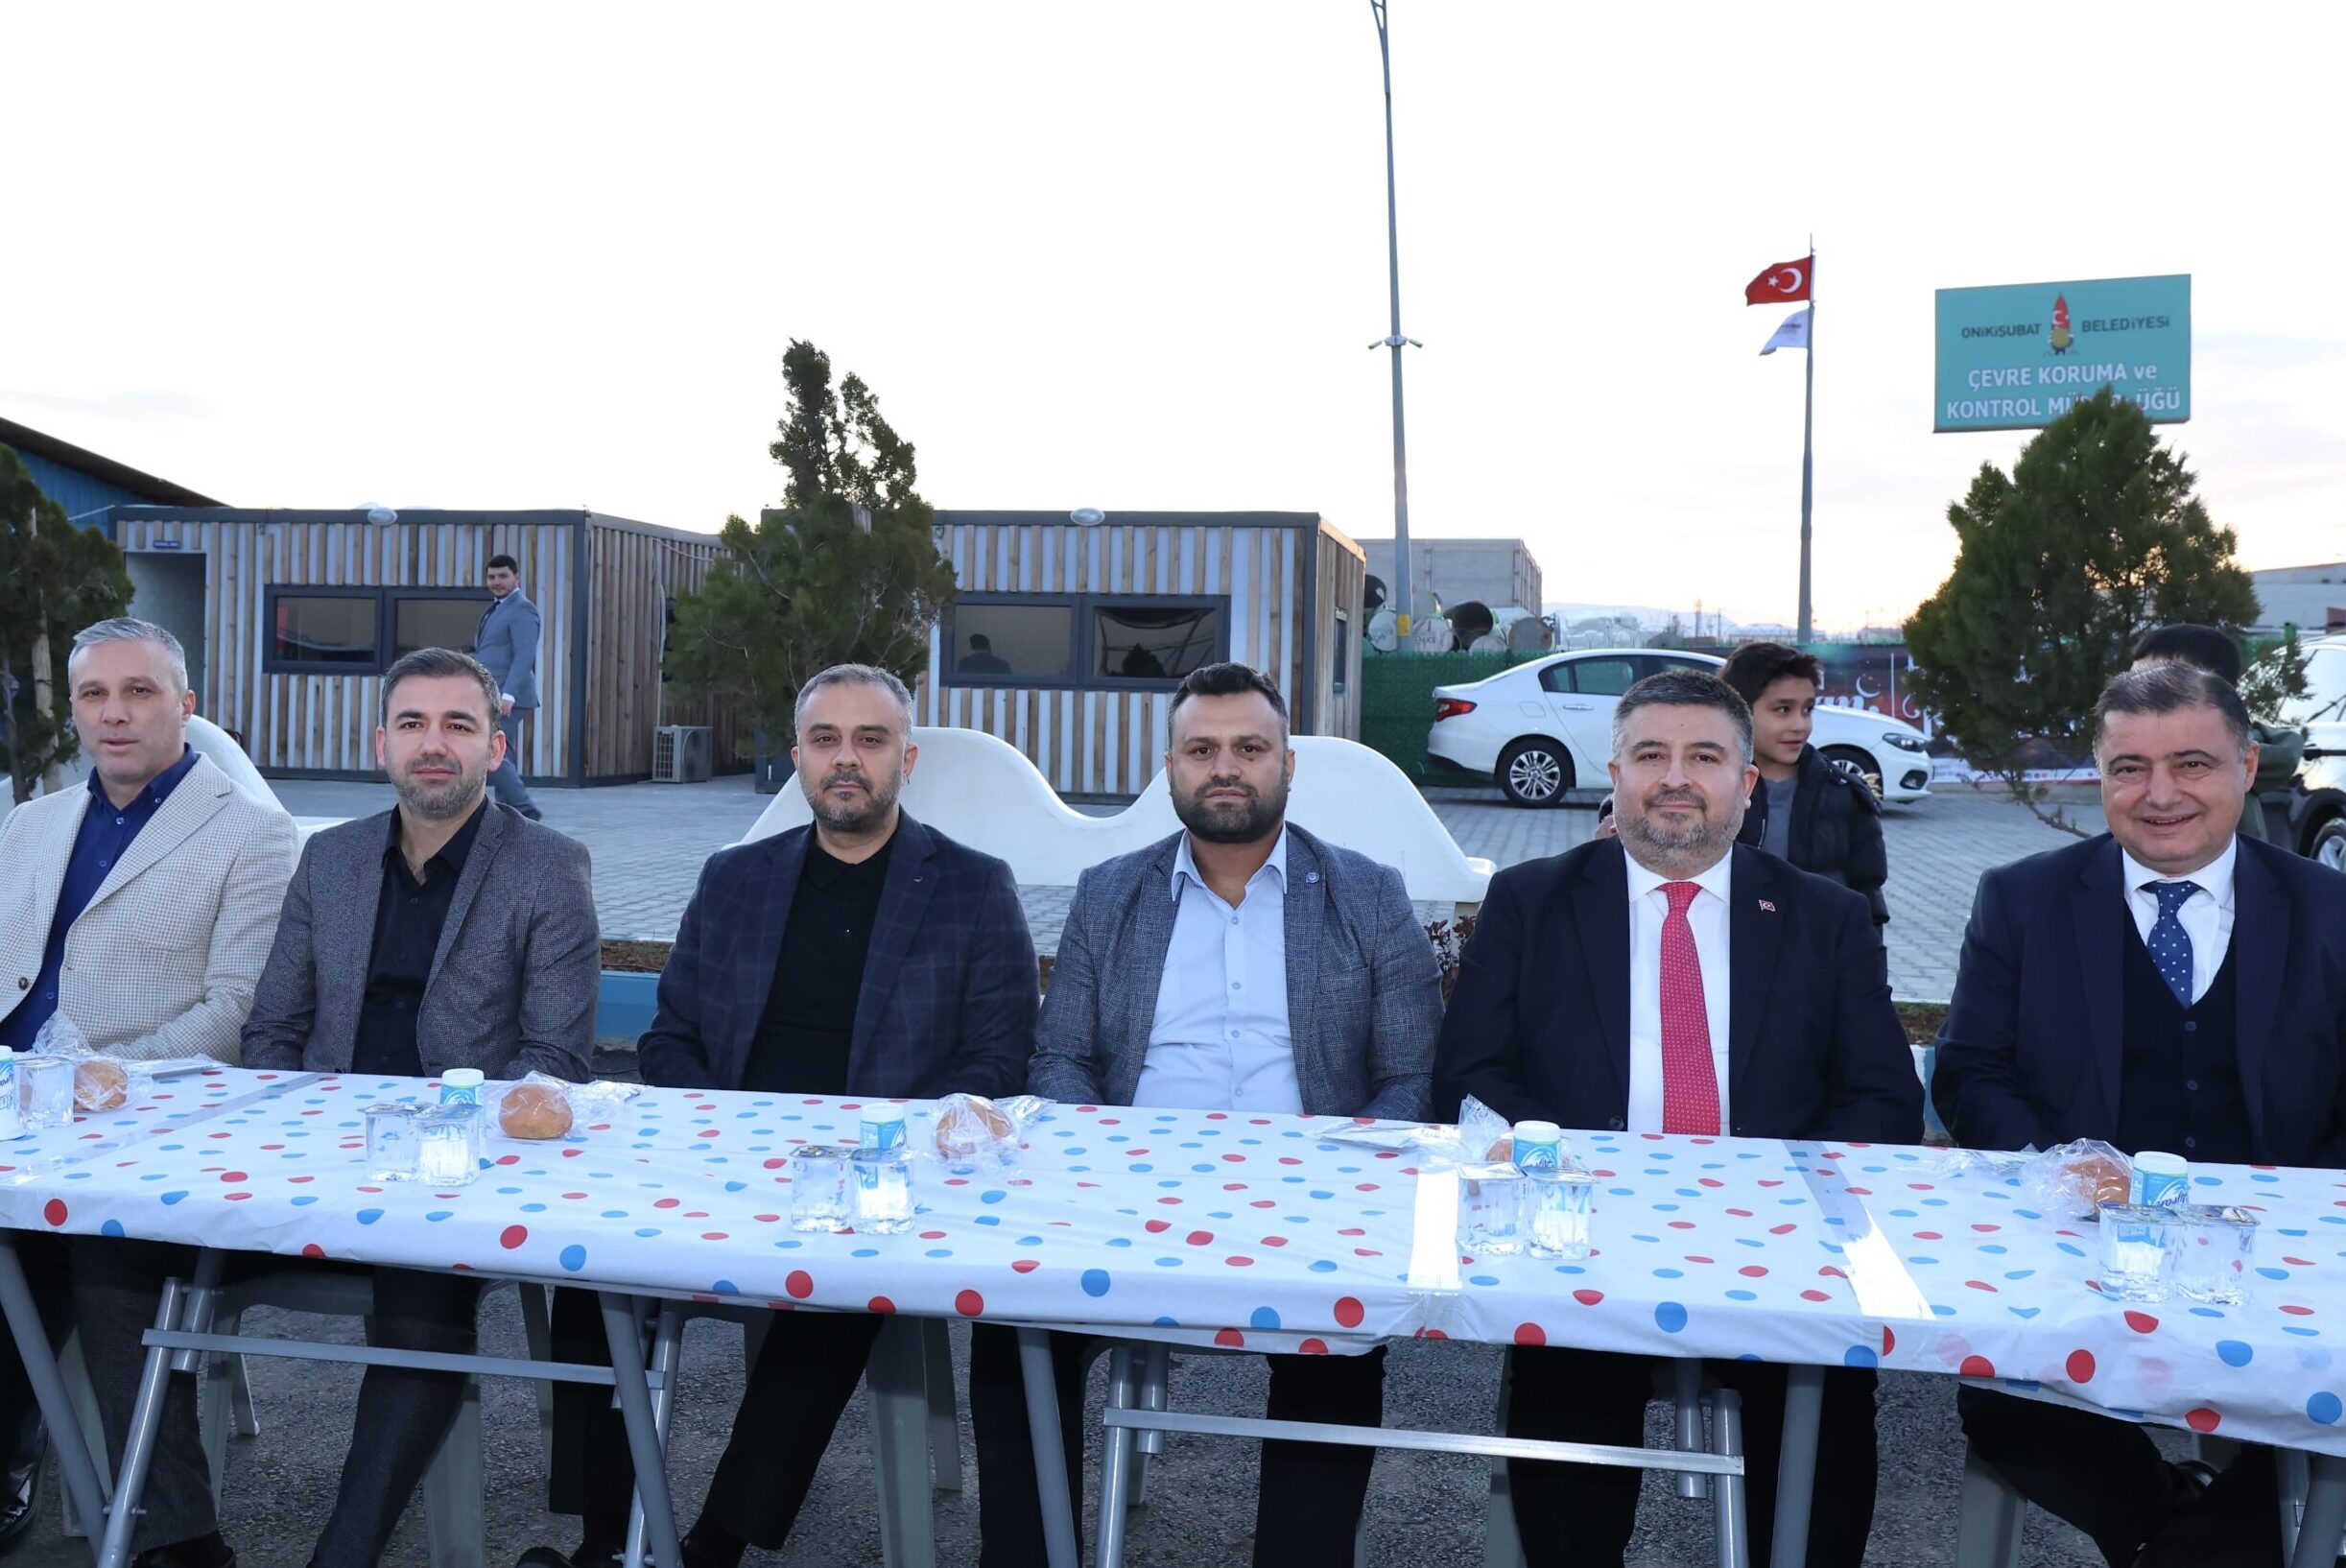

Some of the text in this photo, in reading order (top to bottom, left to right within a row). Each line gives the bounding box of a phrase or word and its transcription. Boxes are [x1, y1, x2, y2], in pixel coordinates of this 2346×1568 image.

[1968, 363, 2157, 392] ÇEVRE KORUMA ve
[1947, 398, 2041, 419] KONTROL
